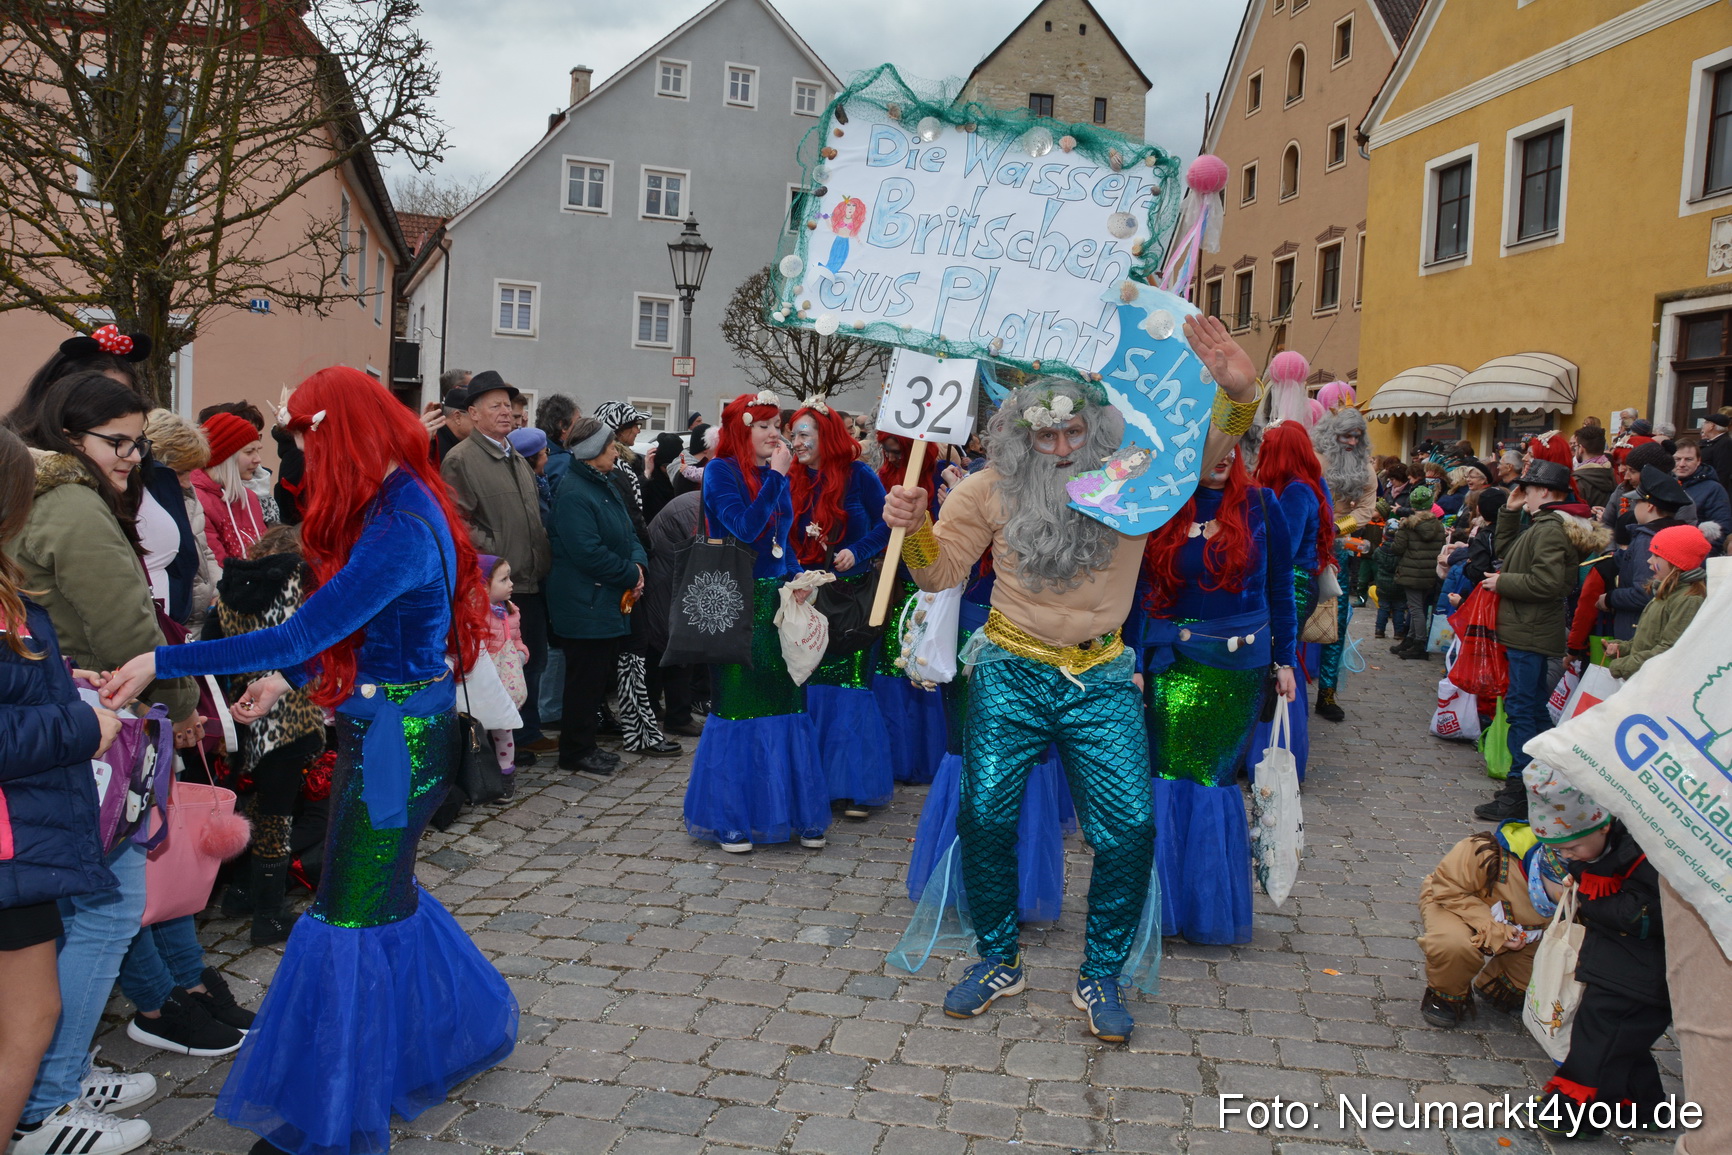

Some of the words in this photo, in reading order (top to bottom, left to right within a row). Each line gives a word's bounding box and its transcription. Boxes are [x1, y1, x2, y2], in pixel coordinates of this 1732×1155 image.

[865, 123, 948, 173] Die
[866, 177, 1132, 288] Britschen
[253, 299, 268, 310] 11
[819, 270, 921, 317] aus
[931, 265, 1118, 373] Plant
[894, 375, 962, 435] 32
